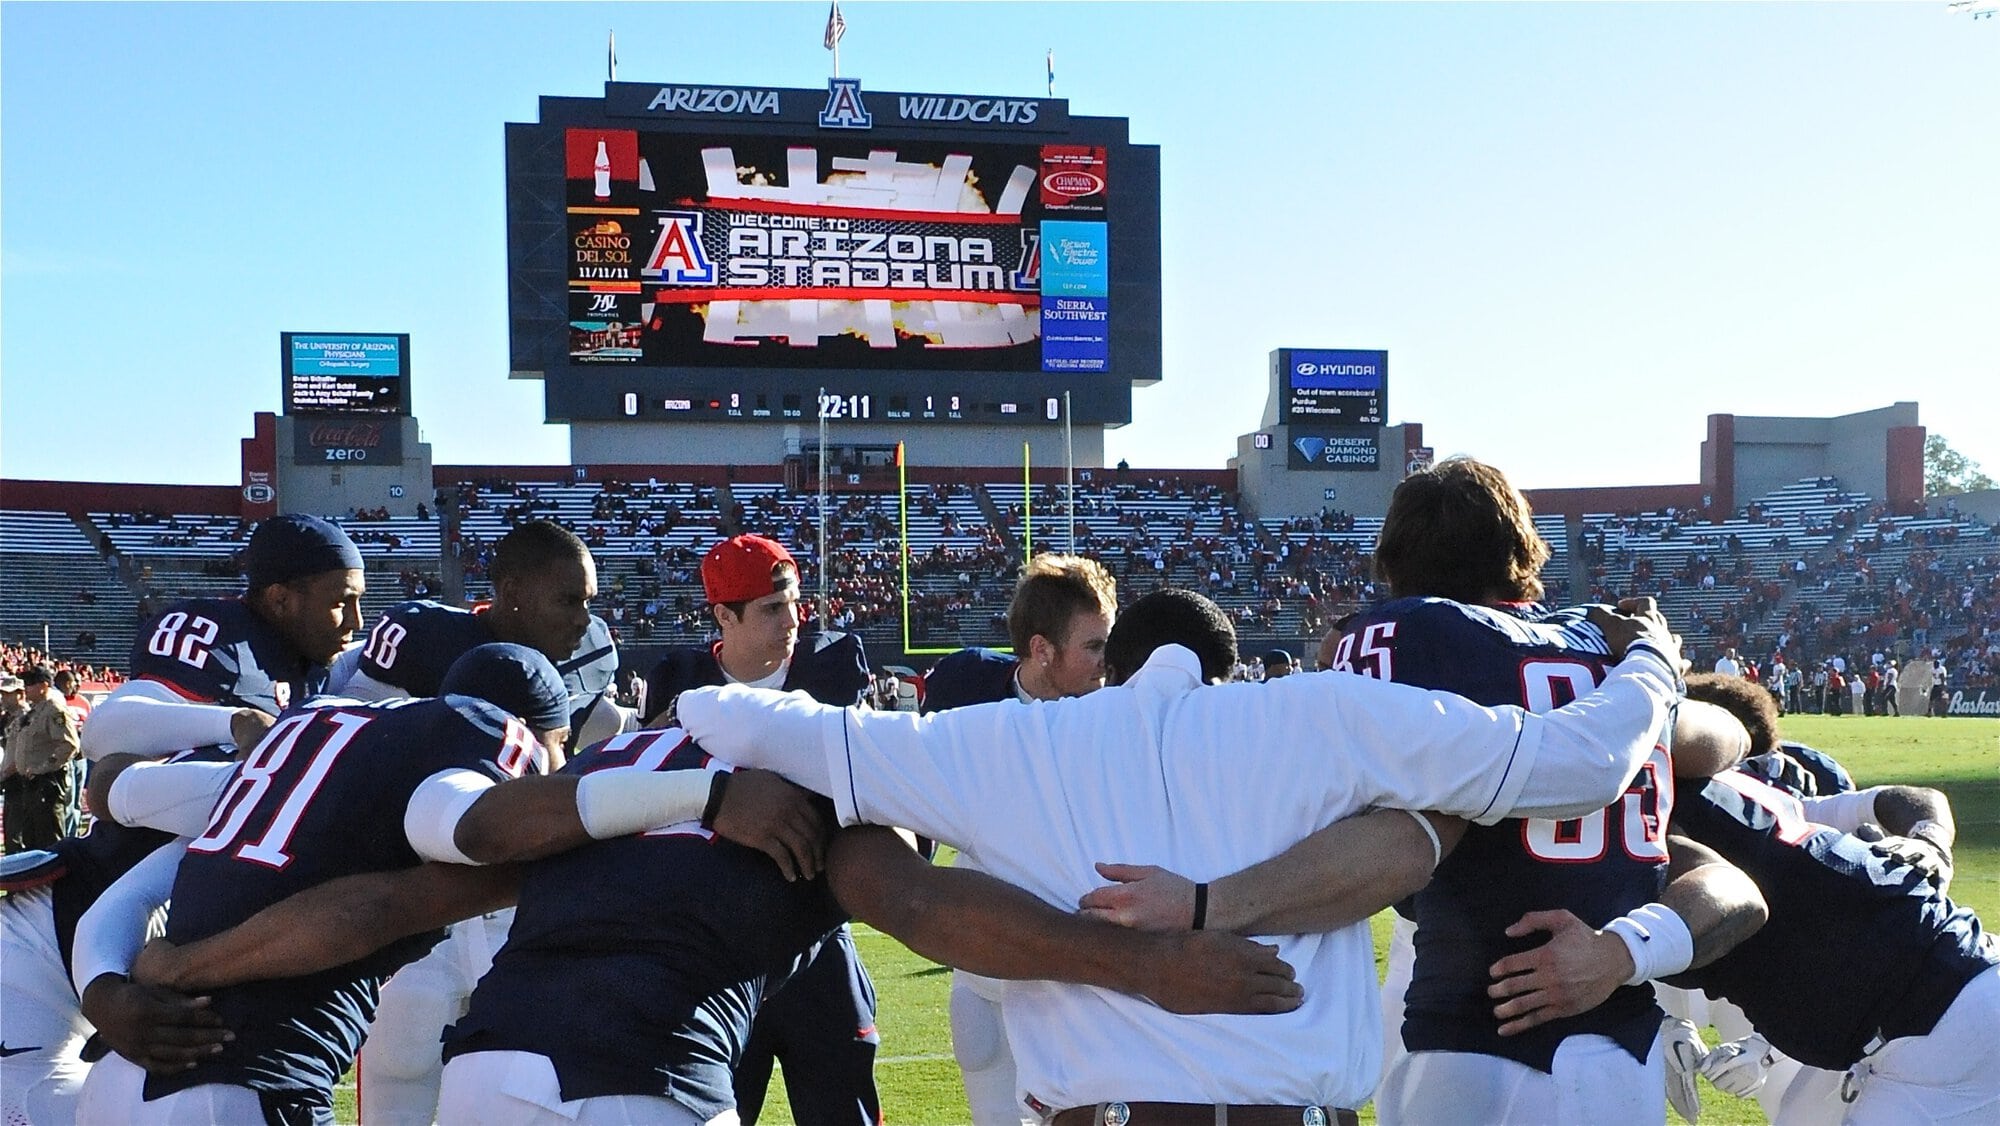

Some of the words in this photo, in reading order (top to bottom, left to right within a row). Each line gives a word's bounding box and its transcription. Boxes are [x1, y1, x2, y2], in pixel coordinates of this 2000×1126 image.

[647, 87, 780, 115] ARIZONA
[819, 77, 872, 130] A
[900, 96, 1039, 124] WILDCATS
[1056, 176, 1091, 187] CHAPMAN
[729, 213, 822, 231] WELCOME
[823, 218, 849, 231] TO
[575, 236, 630, 250] CASINO
[640, 210, 718, 286] A
[729, 227, 993, 263] ARIZONA
[576, 250, 603, 263] DEL
[605, 250, 632, 264] SOL
[1063, 248, 1098, 257] Electric
[1067, 256, 1098, 265] Power
[579, 267, 629, 279] 11/11/11
[728, 257, 1004, 290] STADIUM
[1057, 299, 1094, 311] SIERRA
[1044, 309, 1107, 321] SOUTHWEST
[295, 342, 309, 350] THE
[310, 342, 350, 351] UNIVERSITY
[351, 343, 361, 351] OF
[362, 343, 395, 352] ARIZONA
[324, 351, 366, 359] PHYSICIANS
[1320, 364, 1376, 376] HYUNDAI
[1297, 388, 1310, 396] Out
[1311, 388, 1319, 396] of
[1338, 389, 1375, 397] scoreboard
[817, 395, 871, 418] 22:11
[1291, 397, 1317, 405] Purdue
[1305, 406, 1342, 414] Wisconsin
[1329, 438, 1372, 446] DESERT
[325, 449, 366, 460] zero
[1324, 446, 1377, 455] DIAMOND
[1326, 454, 1376, 463] CASINOS
[848, 474, 859, 484] 12
[390, 486, 403, 496] 10
[1325, 490, 1335, 499] 14
[147, 611, 220, 671] 82
[364, 614, 409, 671] 18
[1333, 621, 1396, 682] 85
[186, 710, 375, 872] 81
